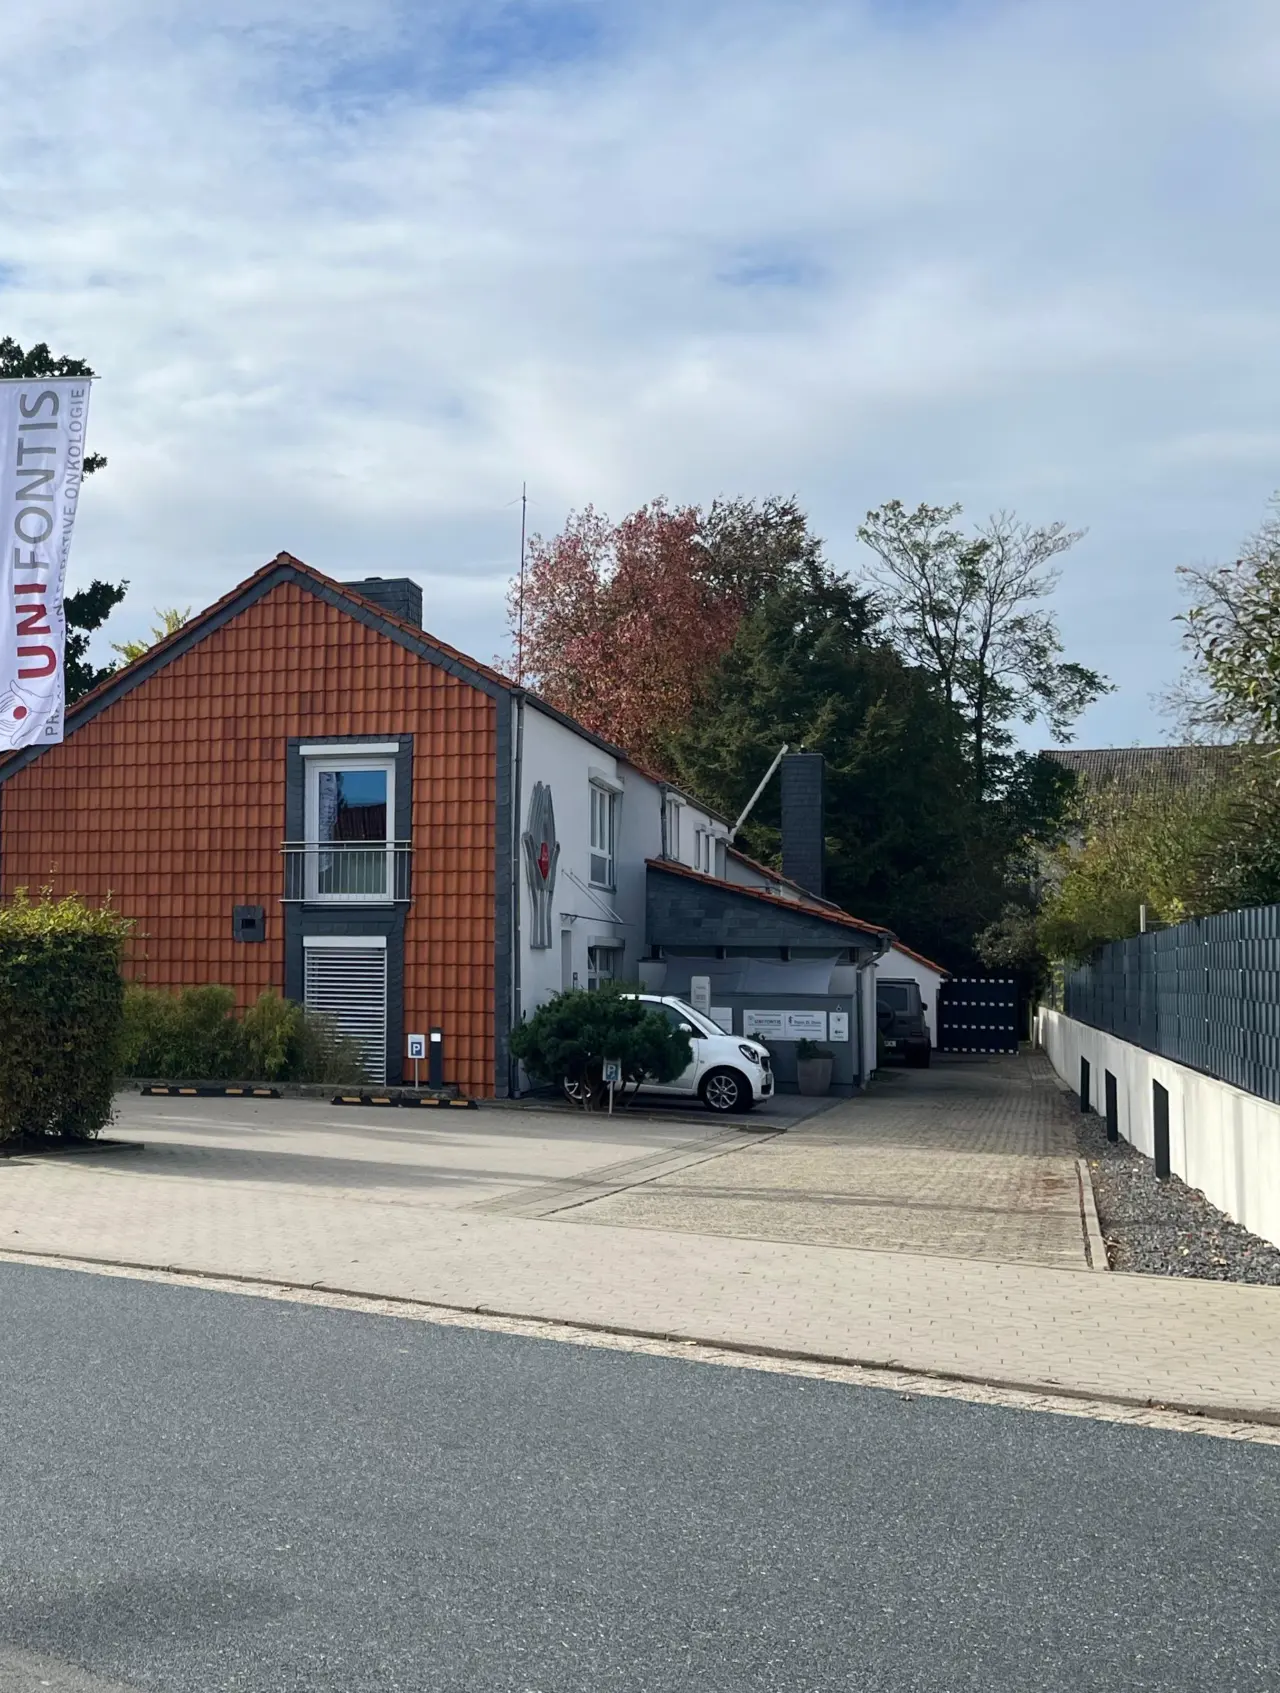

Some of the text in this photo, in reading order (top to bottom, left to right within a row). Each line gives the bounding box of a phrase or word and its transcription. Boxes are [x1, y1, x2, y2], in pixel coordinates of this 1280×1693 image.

[64, 388, 85, 499] ONKOLOGIE
[13, 389, 61, 680] UNIFONTIS
[412, 1043, 421, 1055] P
